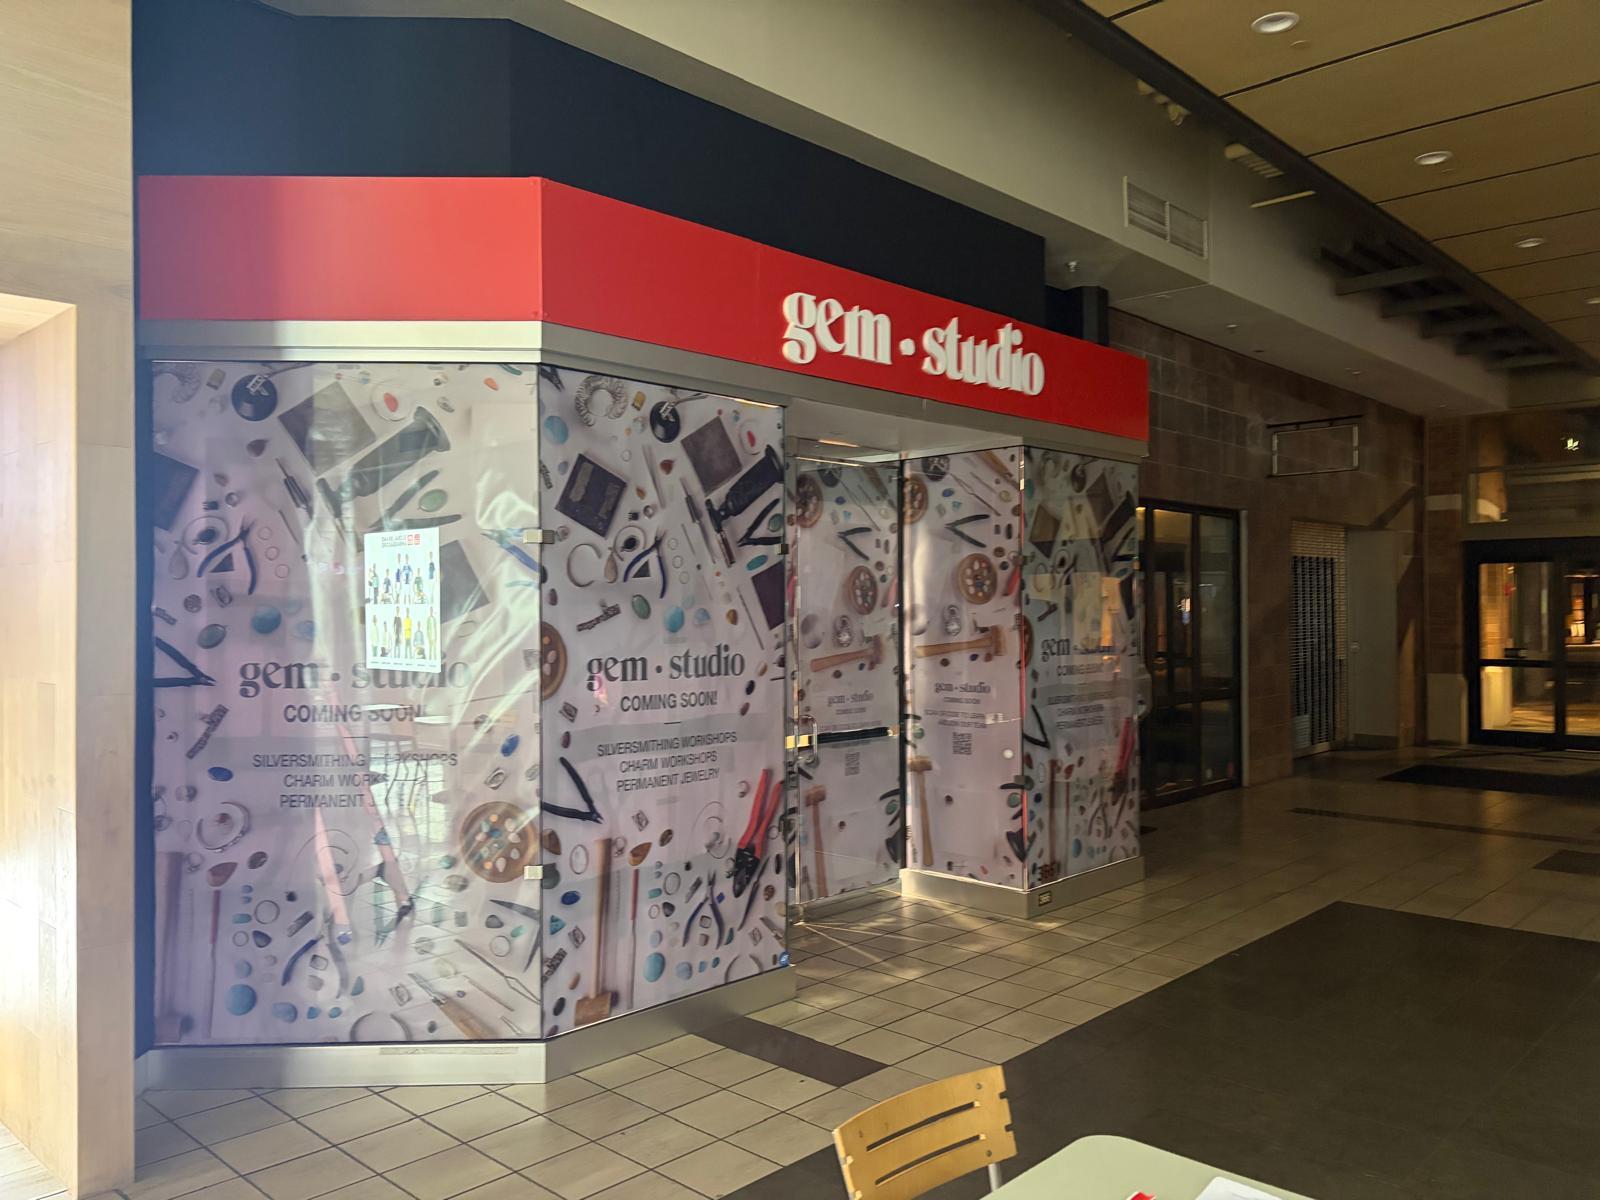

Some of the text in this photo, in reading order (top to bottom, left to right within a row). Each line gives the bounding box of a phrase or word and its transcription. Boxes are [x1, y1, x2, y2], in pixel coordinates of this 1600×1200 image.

[782, 292, 1045, 396] gem studio
[586, 643, 745, 691] gem studio
[240, 660, 319, 698] gem
[620, 690, 718, 712] COMING SOON!
[284, 704, 361, 723] COMING
[597, 732, 737, 757] SILVERSMITHING WORKSHOPS
[252, 753, 366, 768] SILVERSMITHING
[619, 751, 718, 774] CHARM WORKSHOPS
[284, 773, 334, 788] CHARM
[617, 768, 720, 793] PERMANENT JEWELRY
[280, 793, 365, 808] PERMANENT
